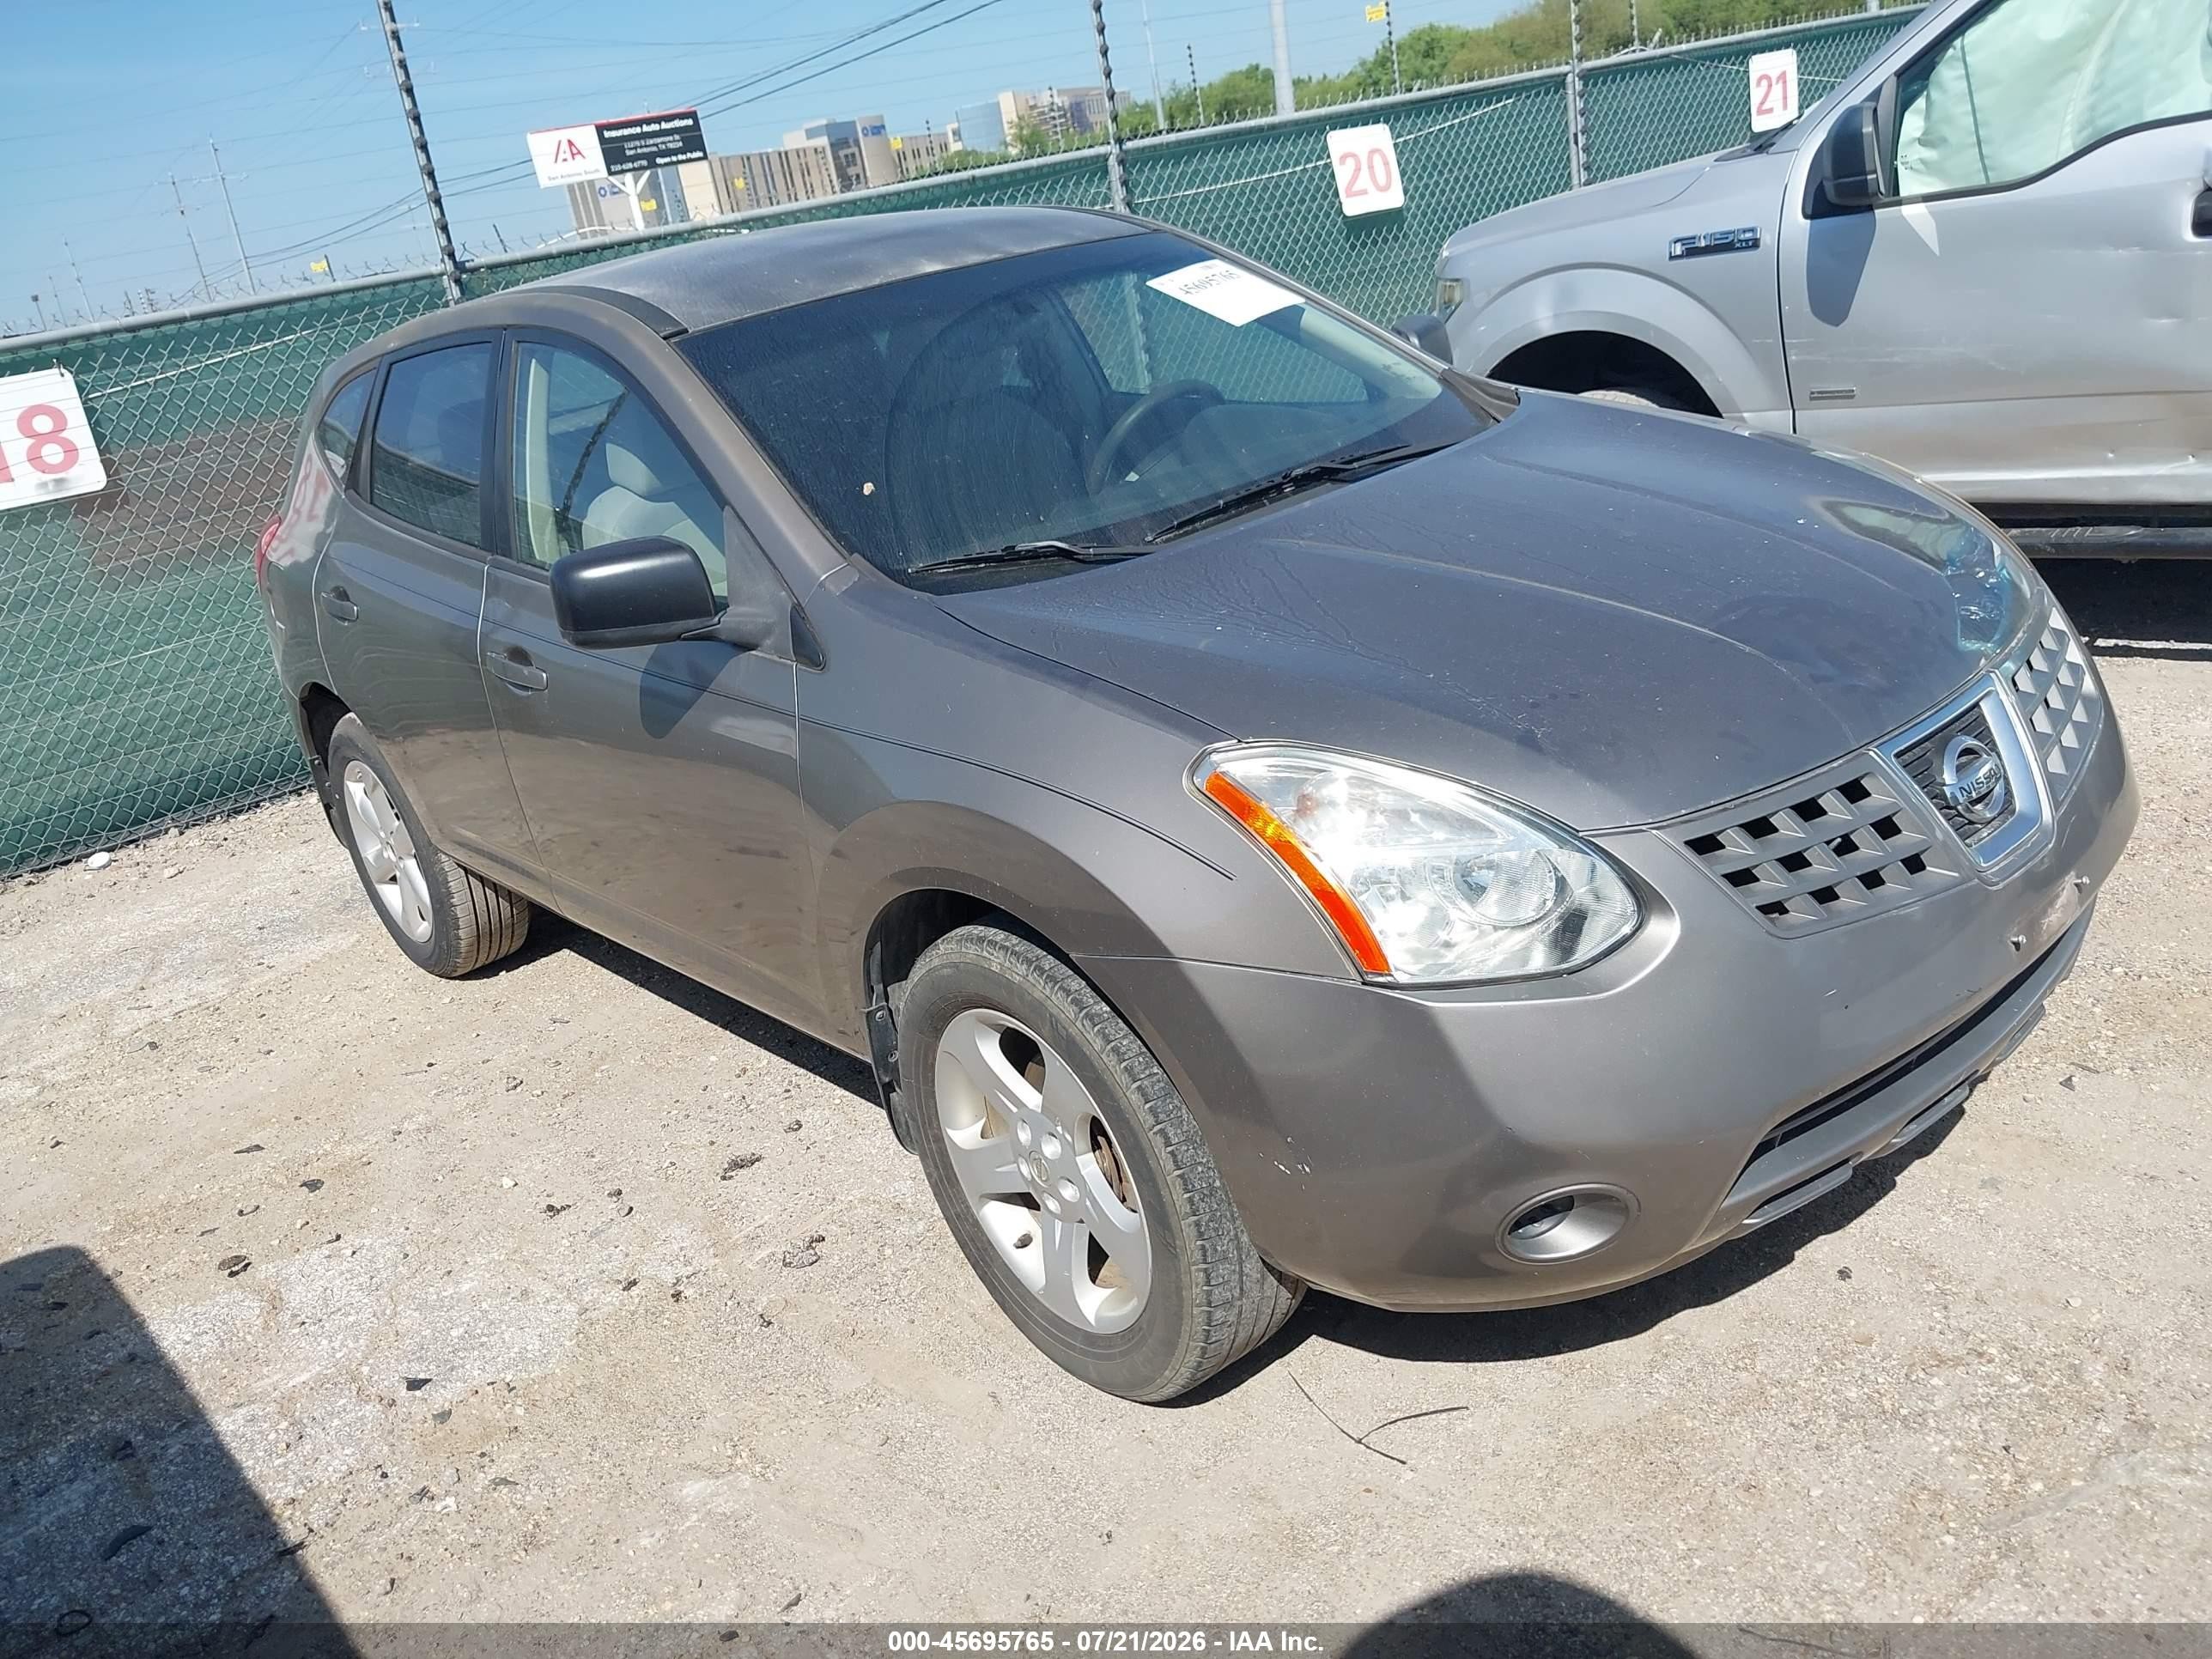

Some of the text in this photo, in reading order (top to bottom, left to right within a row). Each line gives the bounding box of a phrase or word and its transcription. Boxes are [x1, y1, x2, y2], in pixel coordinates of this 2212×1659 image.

[1755, 70, 1788, 116] 21
[603, 118, 694, 138] Insurance Auto Auctions
[655, 156, 671, 165] Open
[686, 150, 704, 159] Public
[1339, 147, 1392, 198] 20
[0, 404, 79, 483] 8
